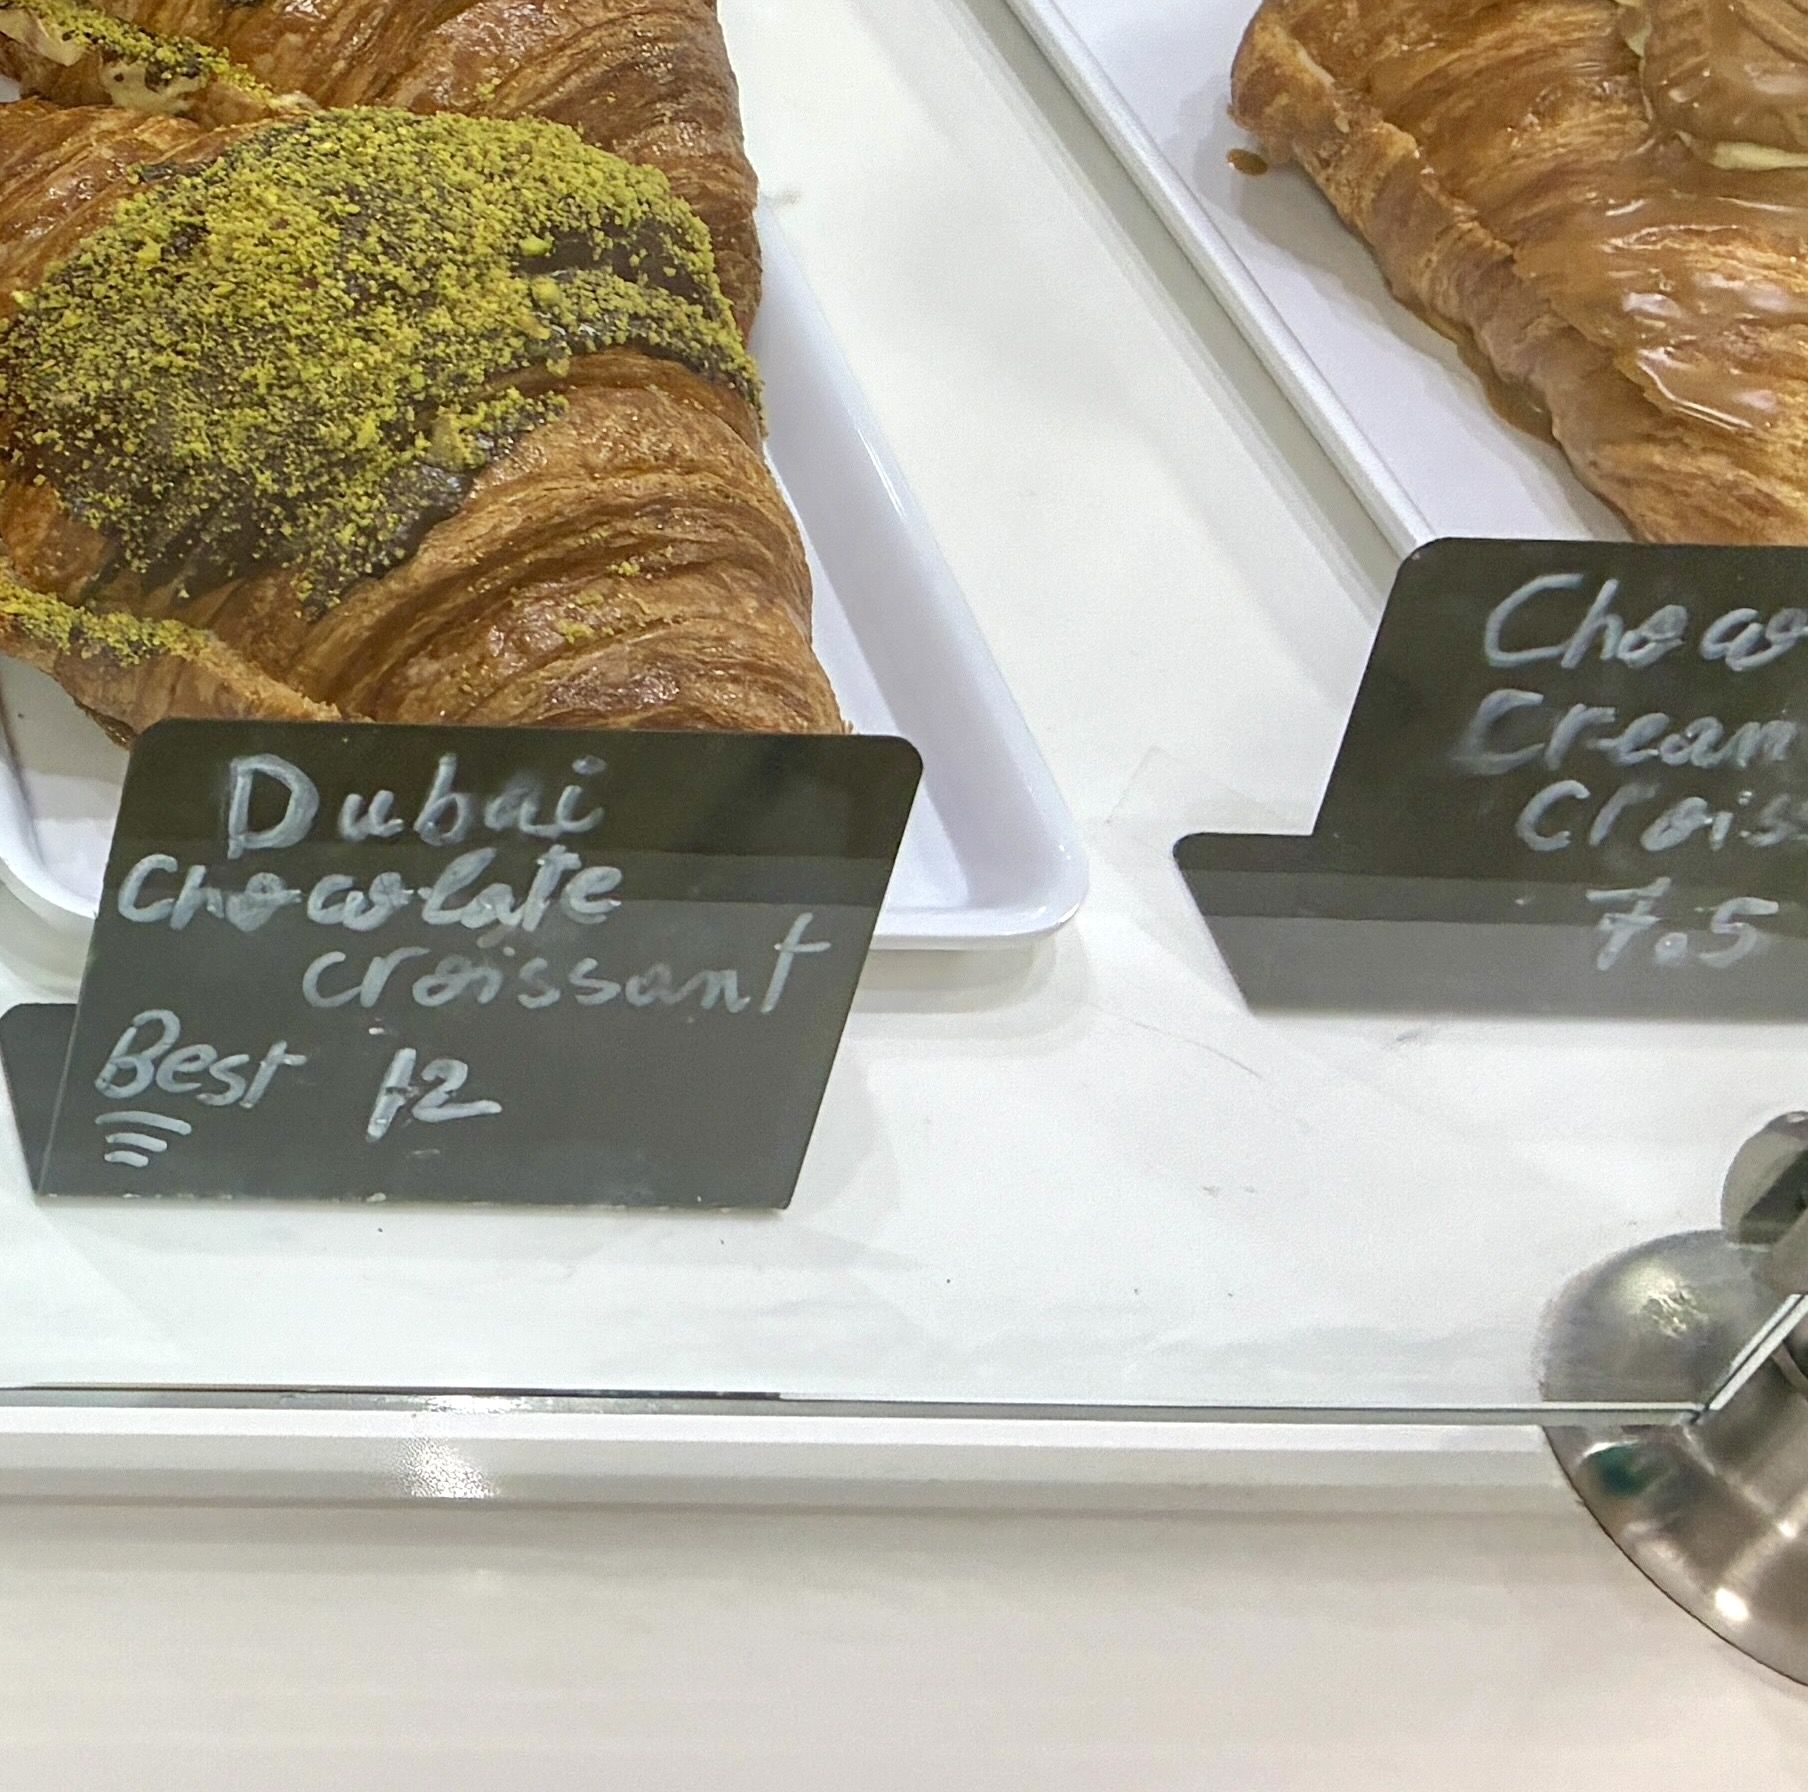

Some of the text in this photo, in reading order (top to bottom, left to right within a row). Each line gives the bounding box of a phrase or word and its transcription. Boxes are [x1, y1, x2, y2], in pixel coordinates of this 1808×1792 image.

[227, 751, 607, 860] Dubai
[301, 912, 832, 1013] croissant
[1585, 876, 1781, 972] 7.5
[93, 1008, 503, 1144] Best 12
